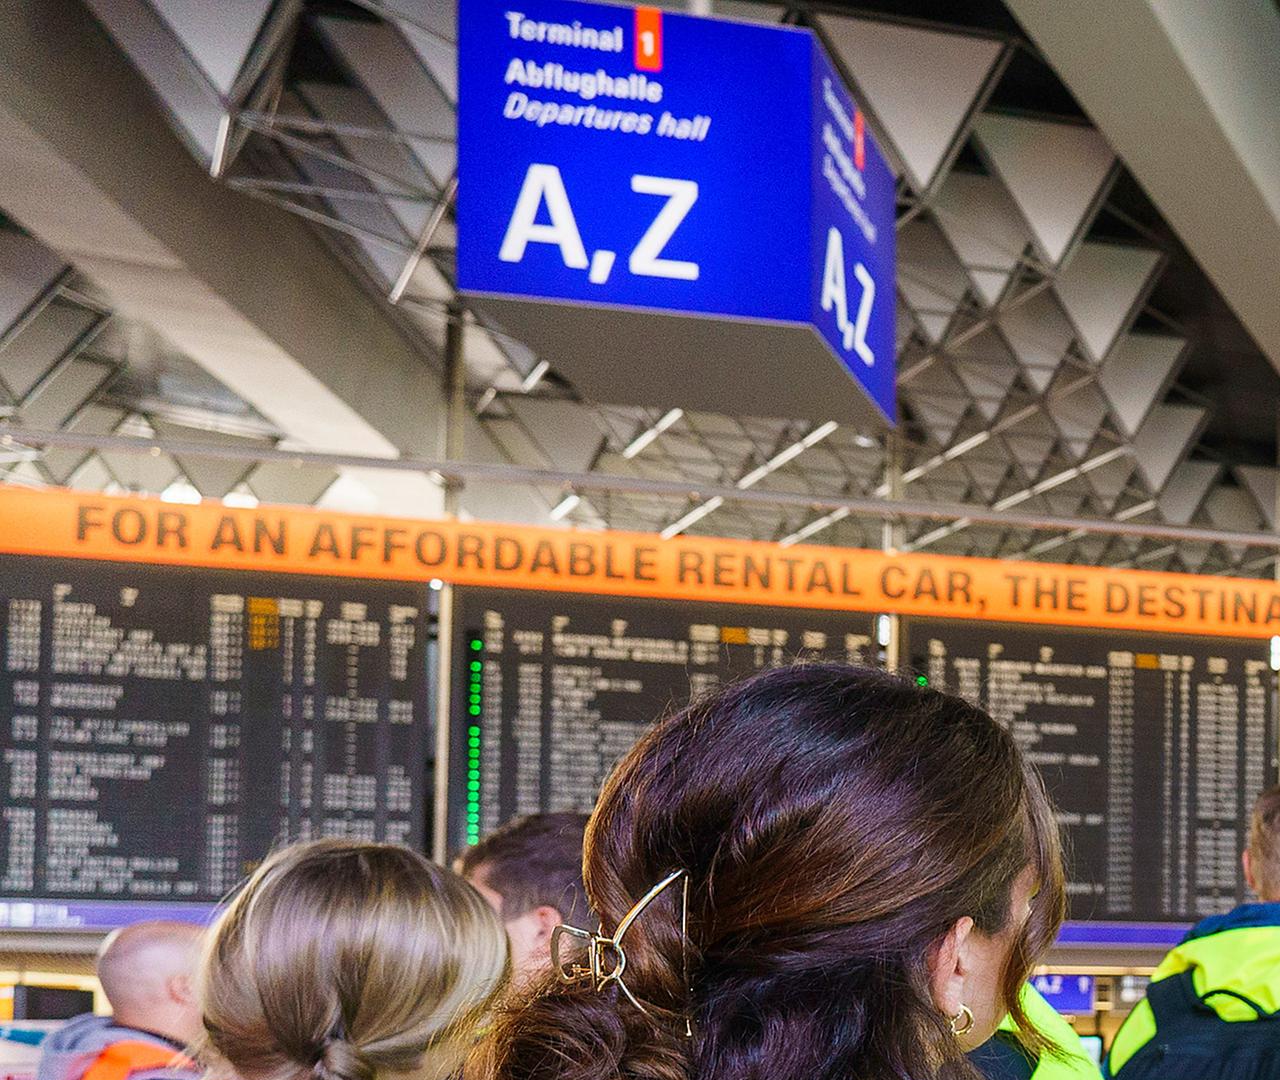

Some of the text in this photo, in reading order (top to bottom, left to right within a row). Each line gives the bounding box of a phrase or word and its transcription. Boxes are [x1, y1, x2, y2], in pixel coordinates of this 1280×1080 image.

[505, 11, 655, 57] Terminal 1
[505, 58, 663, 103] Abflughalle
[503, 92, 712, 141] Departures hall
[76, 506, 190, 549] FOR
[210, 515, 287, 555] AN
[308, 522, 656, 582] AFFORDABLE
[678, 551, 860, 596] RENTAL
[880, 565, 986, 613] CAR,
[1005, 574, 1088, 611] THE
